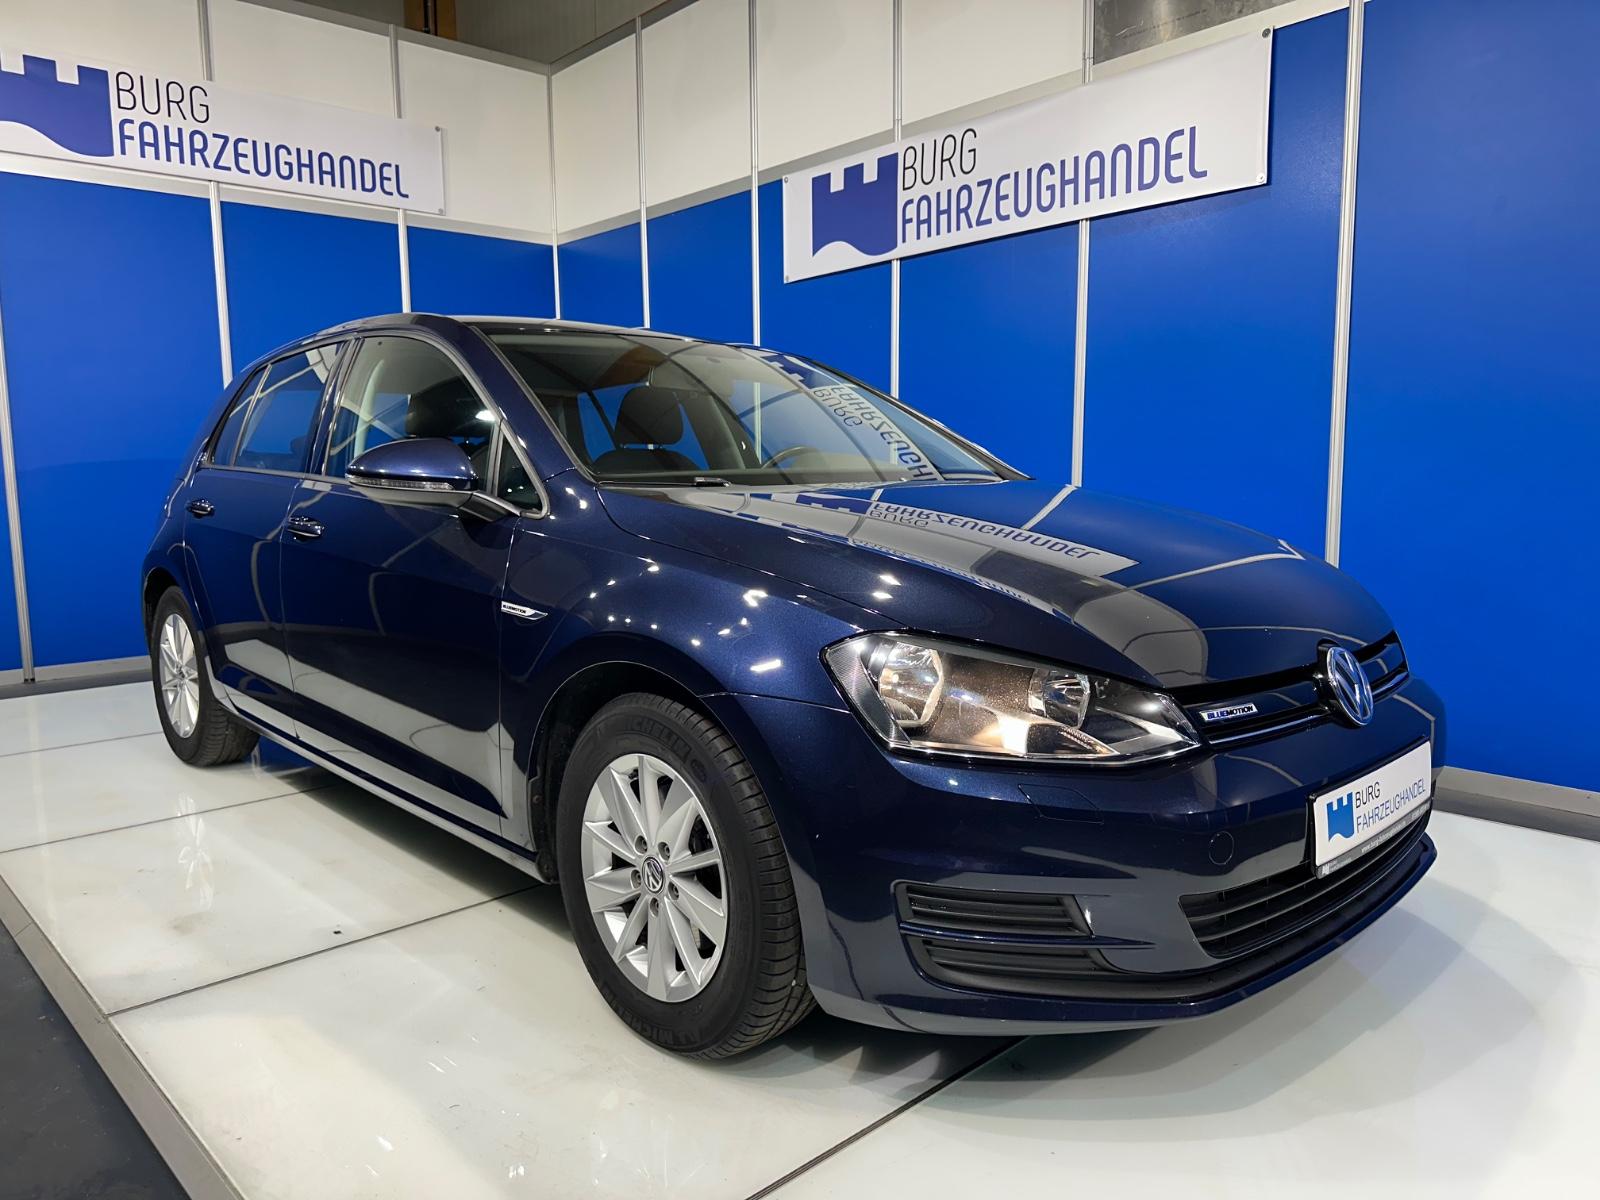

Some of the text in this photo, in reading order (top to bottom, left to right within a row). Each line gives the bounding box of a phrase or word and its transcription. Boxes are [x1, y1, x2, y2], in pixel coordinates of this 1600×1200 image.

[115, 71, 211, 124] BURG
[118, 118, 409, 199] FAHRZEUGHANDEL
[902, 128, 978, 192] BURG
[902, 125, 1208, 245] FAHRZEUGHANDEL
[1206, 705, 1254, 720] BLUEMOTION
[1355, 781, 1381, 809] BURG
[1356, 778, 1426, 834] FAHRZEUGHANDEL
